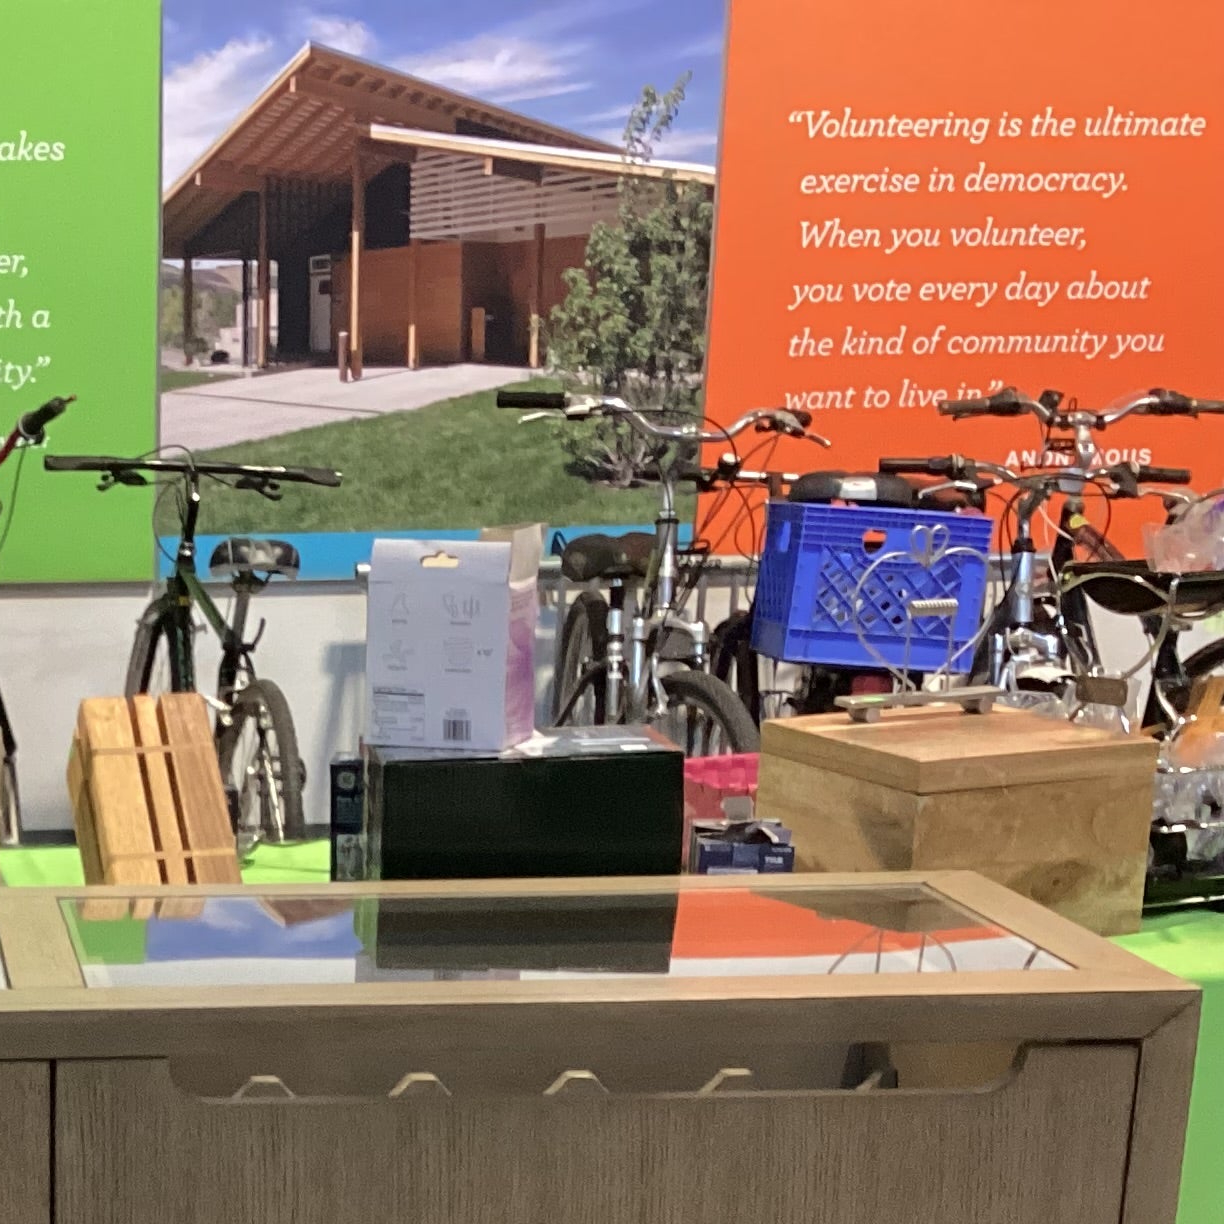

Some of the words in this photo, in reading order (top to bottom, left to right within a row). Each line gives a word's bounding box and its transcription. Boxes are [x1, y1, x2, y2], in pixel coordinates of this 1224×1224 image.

[998, 112, 1023, 138] is
[1031, 106, 1076, 138] the
[1085, 106, 1207, 137] ultimate
[800, 167, 921, 195] exercise
[928, 166, 956, 193] in
[964, 161, 1128, 199] democracy.
[799, 218, 881, 249] When
[885, 230, 941, 254] you
[950, 216, 1087, 251] volunteer,
[788, 283, 843, 311] you
[852, 278, 912, 303] vote
[919, 282, 998, 308] every
[1005, 271, 1060, 307] day
[1067, 270, 1152, 301] about
[31, 310, 51, 329] a
[788, 326, 834, 357] the
[841, 325, 907, 356] kind
[912, 325, 946, 355] of
[947, 328, 1108, 360] community
[1109, 332, 1165, 360] you
[784, 386, 857, 411] want
[863, 385, 891, 409] to
[899, 378, 949, 409] live
